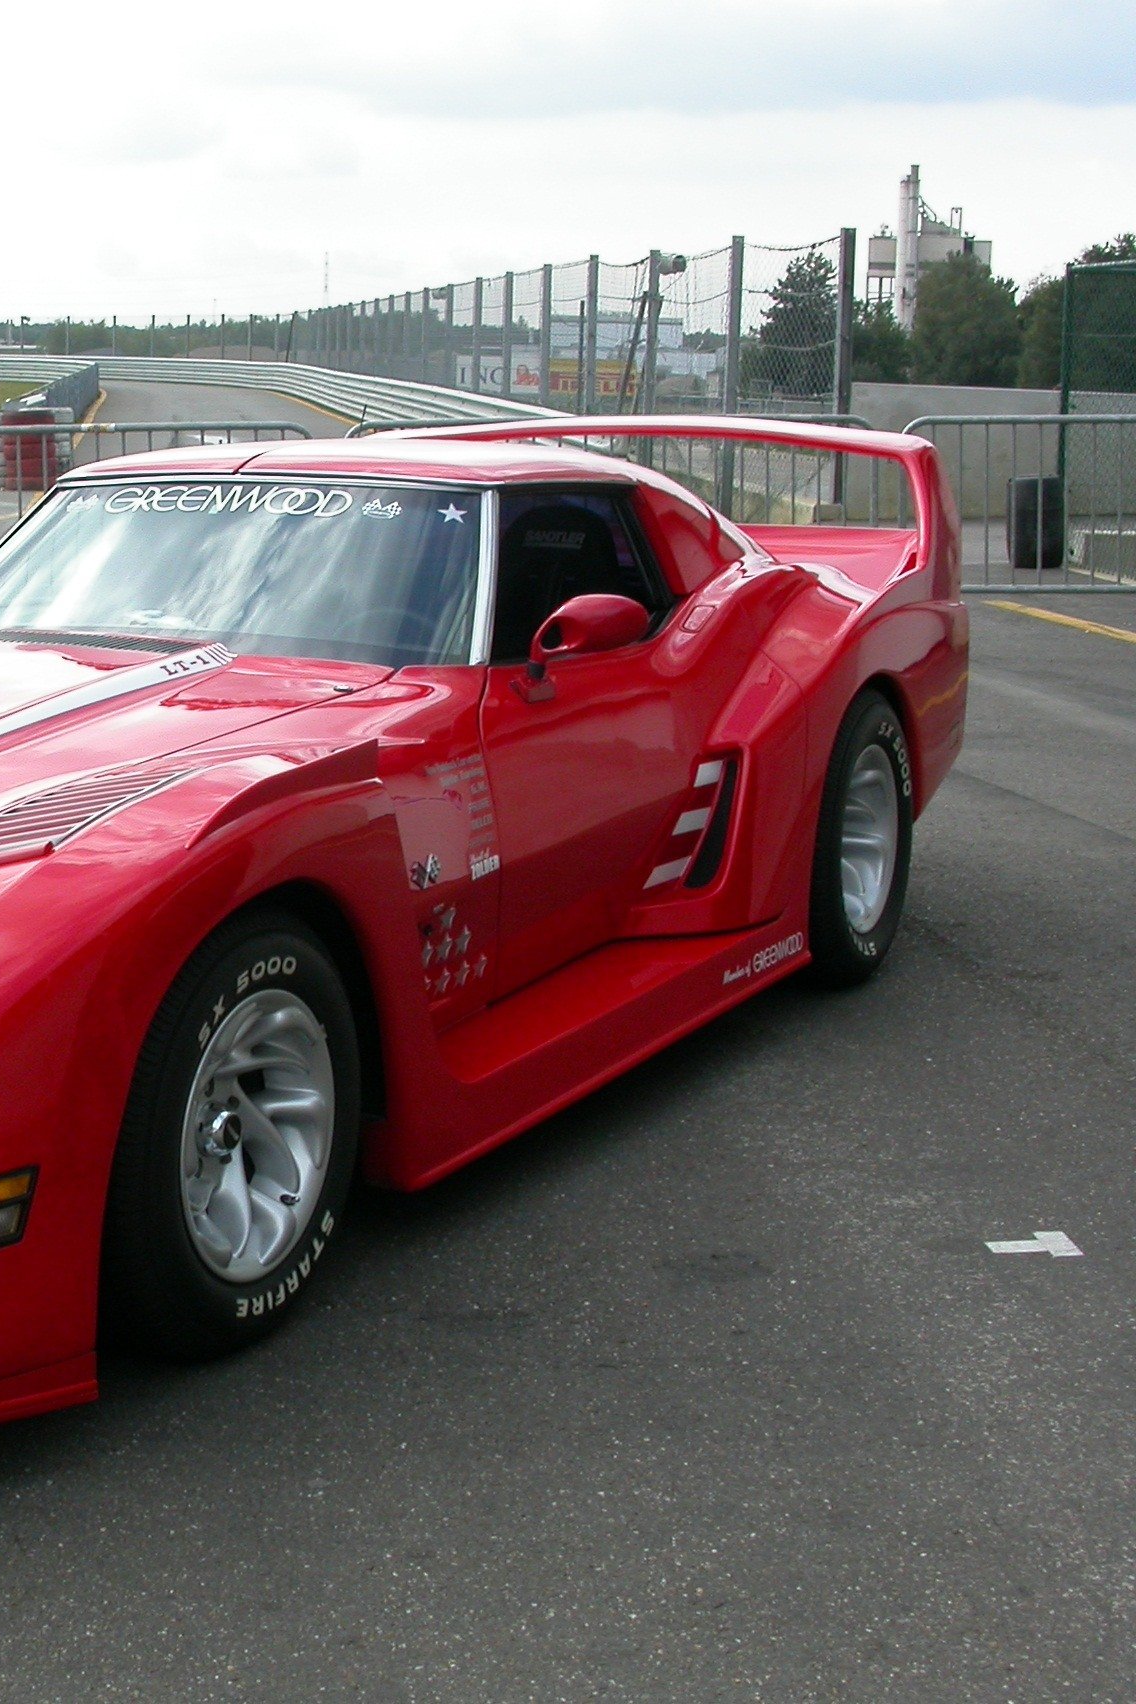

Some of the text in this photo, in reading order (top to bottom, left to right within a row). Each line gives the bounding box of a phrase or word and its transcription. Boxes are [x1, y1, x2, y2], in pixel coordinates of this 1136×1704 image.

[104, 486, 353, 518] GREENWOOD
[160, 655, 210, 675] LT-1
[197, 956, 298, 1050] SX 5000
[235, 1209, 335, 1318] STARFIRE
